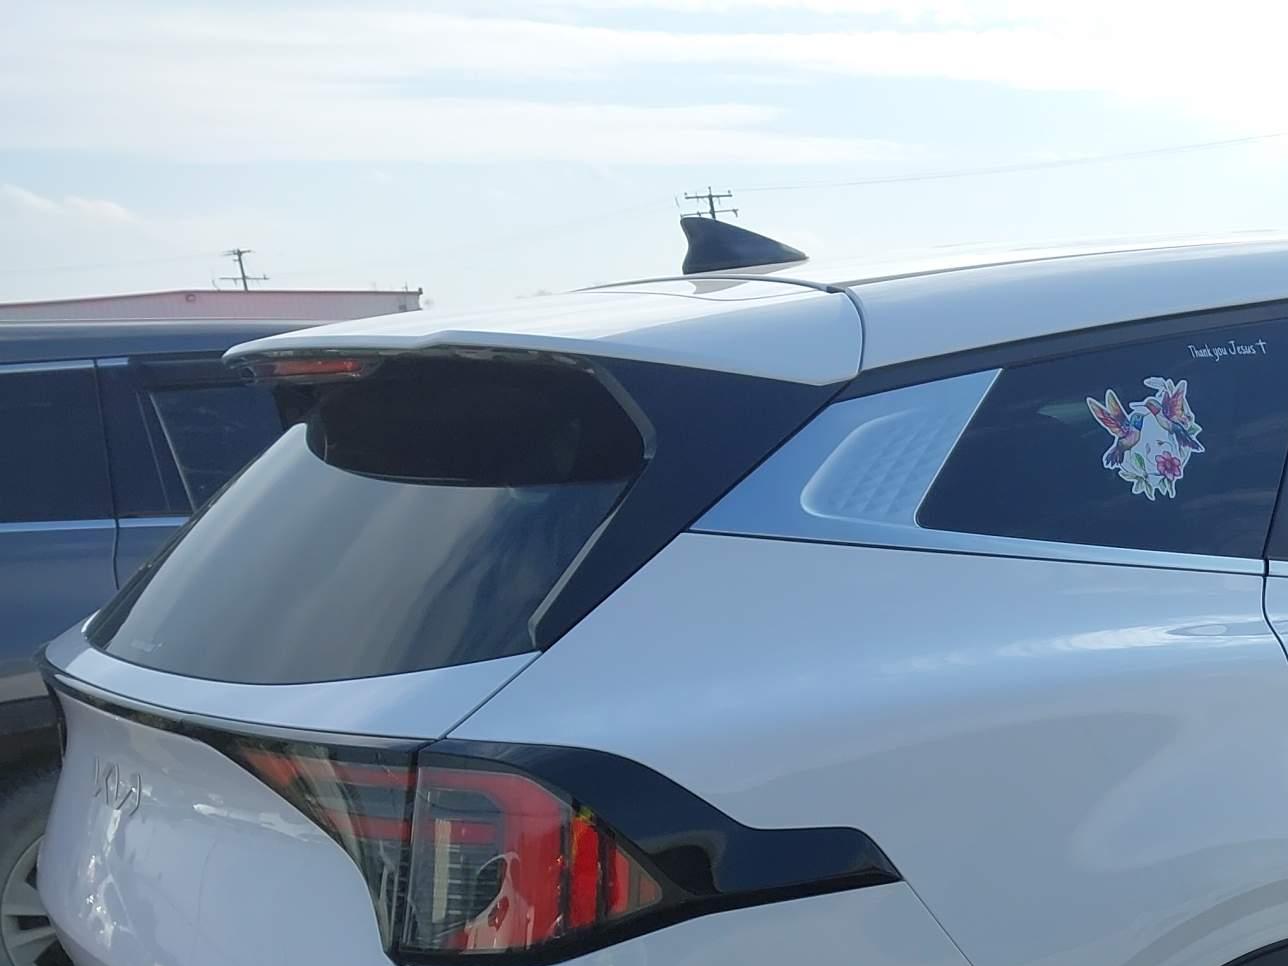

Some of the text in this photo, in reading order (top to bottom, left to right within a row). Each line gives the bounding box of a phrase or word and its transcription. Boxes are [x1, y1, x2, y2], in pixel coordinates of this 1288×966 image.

[1188, 340, 1256, 361] Thank you Jesus
